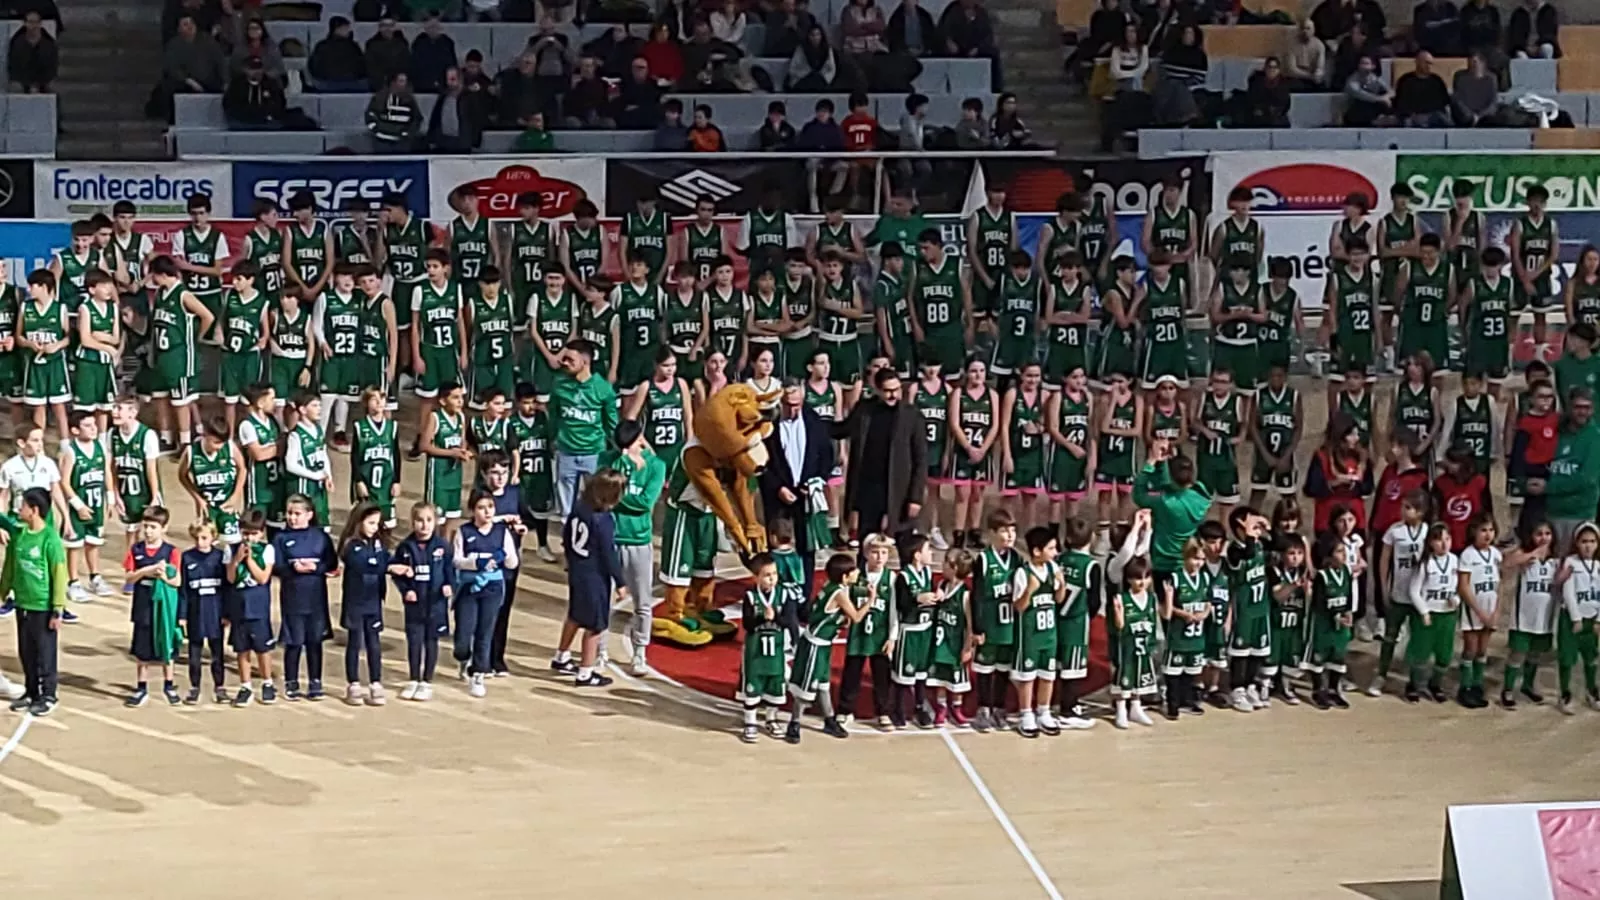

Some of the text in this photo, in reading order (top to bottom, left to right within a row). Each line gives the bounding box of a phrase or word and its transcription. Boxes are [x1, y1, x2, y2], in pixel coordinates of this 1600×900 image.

[1084, 240, 1099, 258] 17
[462, 259, 480, 278] 57
[524, 262, 542, 281] 16
[927, 303, 950, 323] 88
[1351, 310, 1370, 330] 22
[1420, 303, 1432, 322] 8
[434, 325, 453, 346] 13
[637, 326, 649, 345] 3
[1013, 317, 1026, 336] 3
[1155, 323, 1178, 342] 20
[1483, 317, 1505, 337] 33
[230, 336, 242, 352] 9
[335, 333, 356, 353] 23
[492, 338, 503, 359] 5
[720, 336, 736, 356] 17
[655, 425, 678, 444] 23
[1270, 432, 1281, 452] 9
[1209, 437, 1222, 455] 11
[118, 474, 141, 495] 70
[371, 466, 384, 488] 0
[86, 487, 102, 507] 19
[570, 516, 590, 559] 12
[864, 614, 873, 635] 6
[1036, 608, 1056, 631] 88
[935, 626, 945, 646] 9
[761, 636, 776, 657] 11
